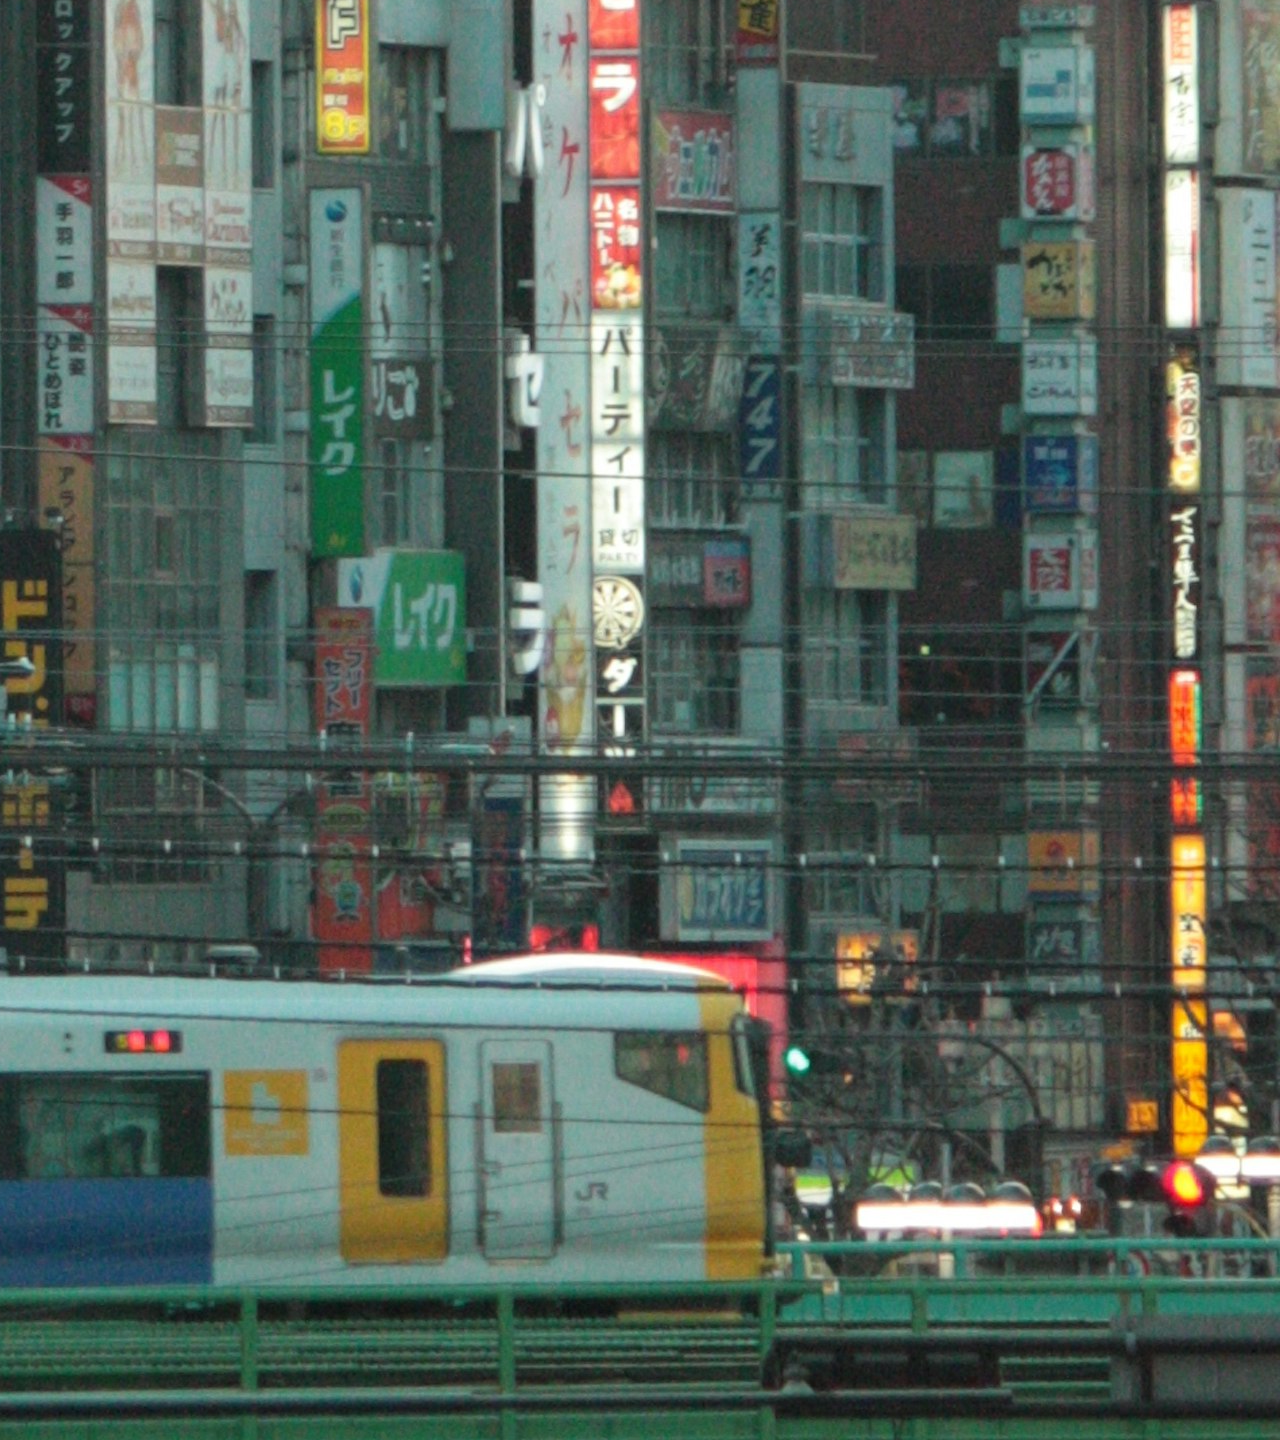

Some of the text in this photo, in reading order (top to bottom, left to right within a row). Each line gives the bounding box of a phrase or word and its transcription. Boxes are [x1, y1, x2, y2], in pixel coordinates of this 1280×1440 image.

[54, 202, 76, 292] 手羽一郎
[592, 192, 615, 267] ハニトー
[320, 370, 357, 478] レイク
[598, 329, 635, 517] パーティー
[744, 360, 779, 476] 747
[392, 583, 457, 651] レイク
[571, 1181, 609, 1201] JR
